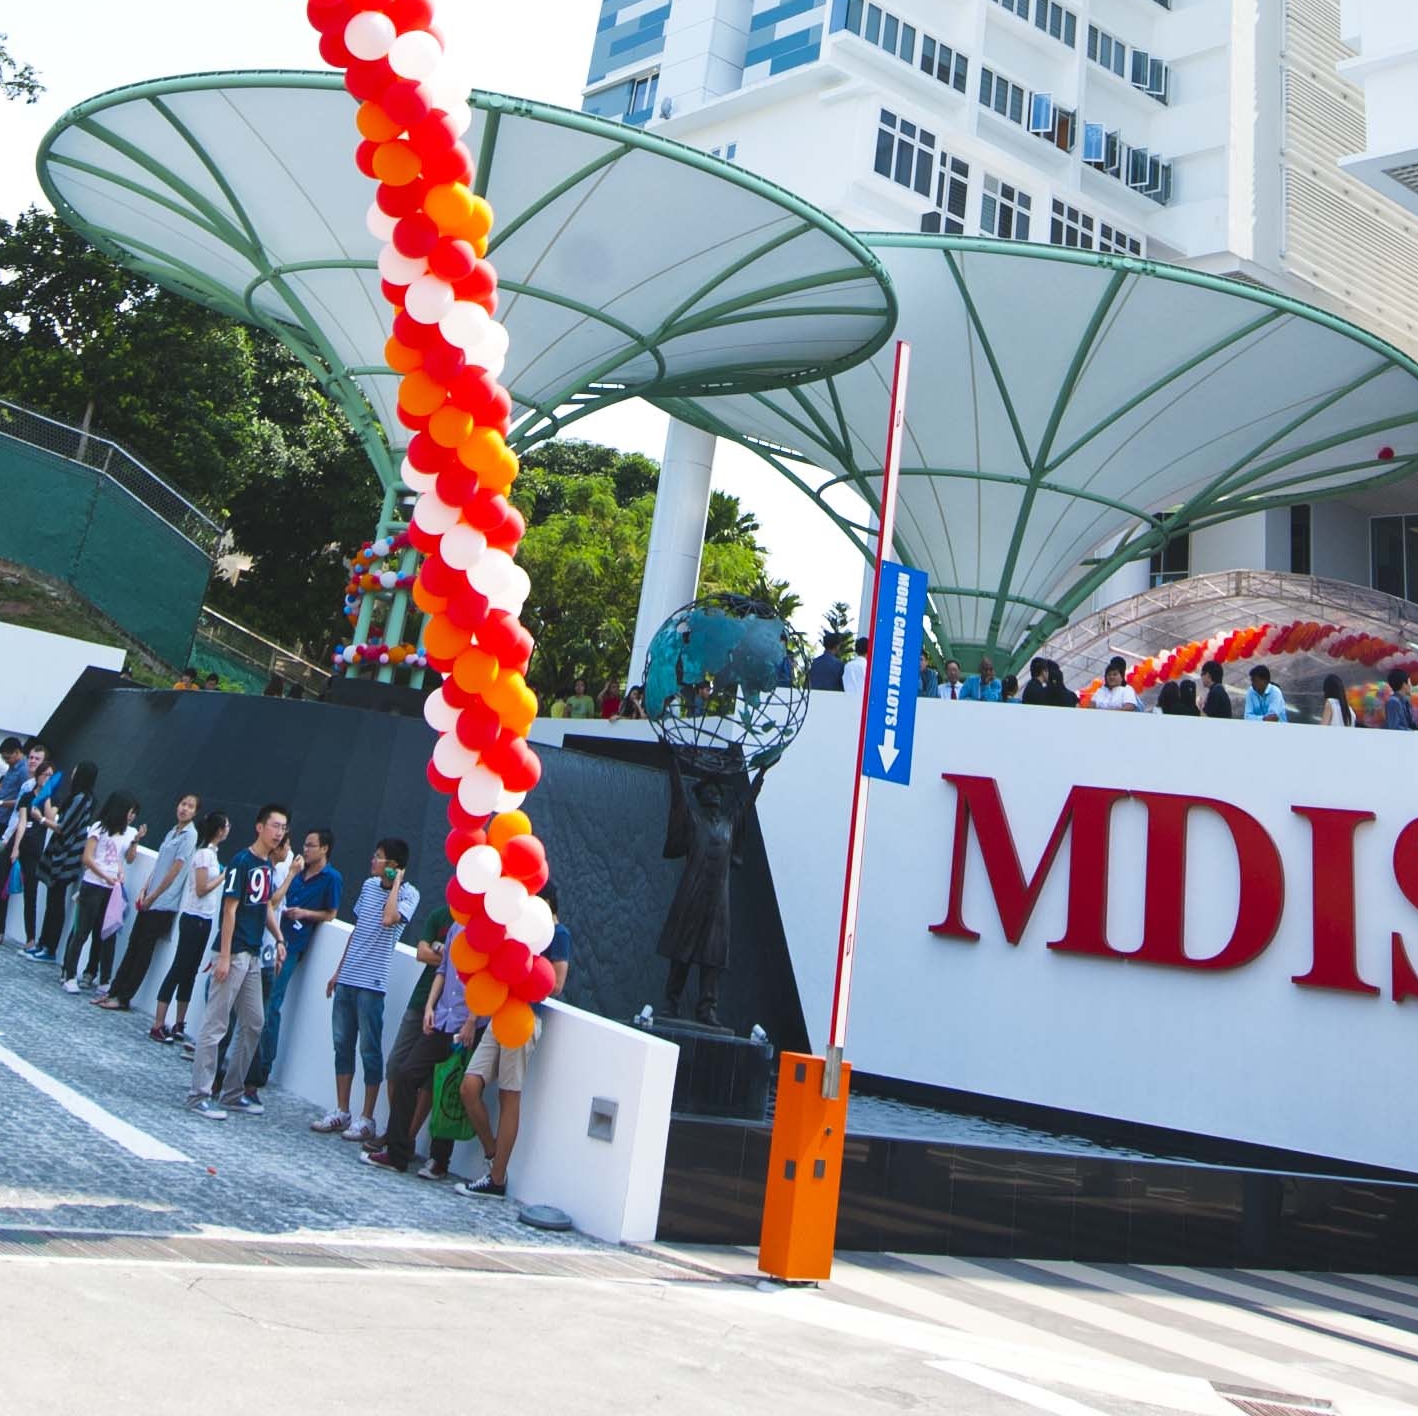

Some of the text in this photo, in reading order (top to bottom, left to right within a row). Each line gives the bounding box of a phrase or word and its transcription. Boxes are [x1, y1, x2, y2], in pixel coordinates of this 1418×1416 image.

[885, 572, 910, 726] MORE CARPARK LOTS
